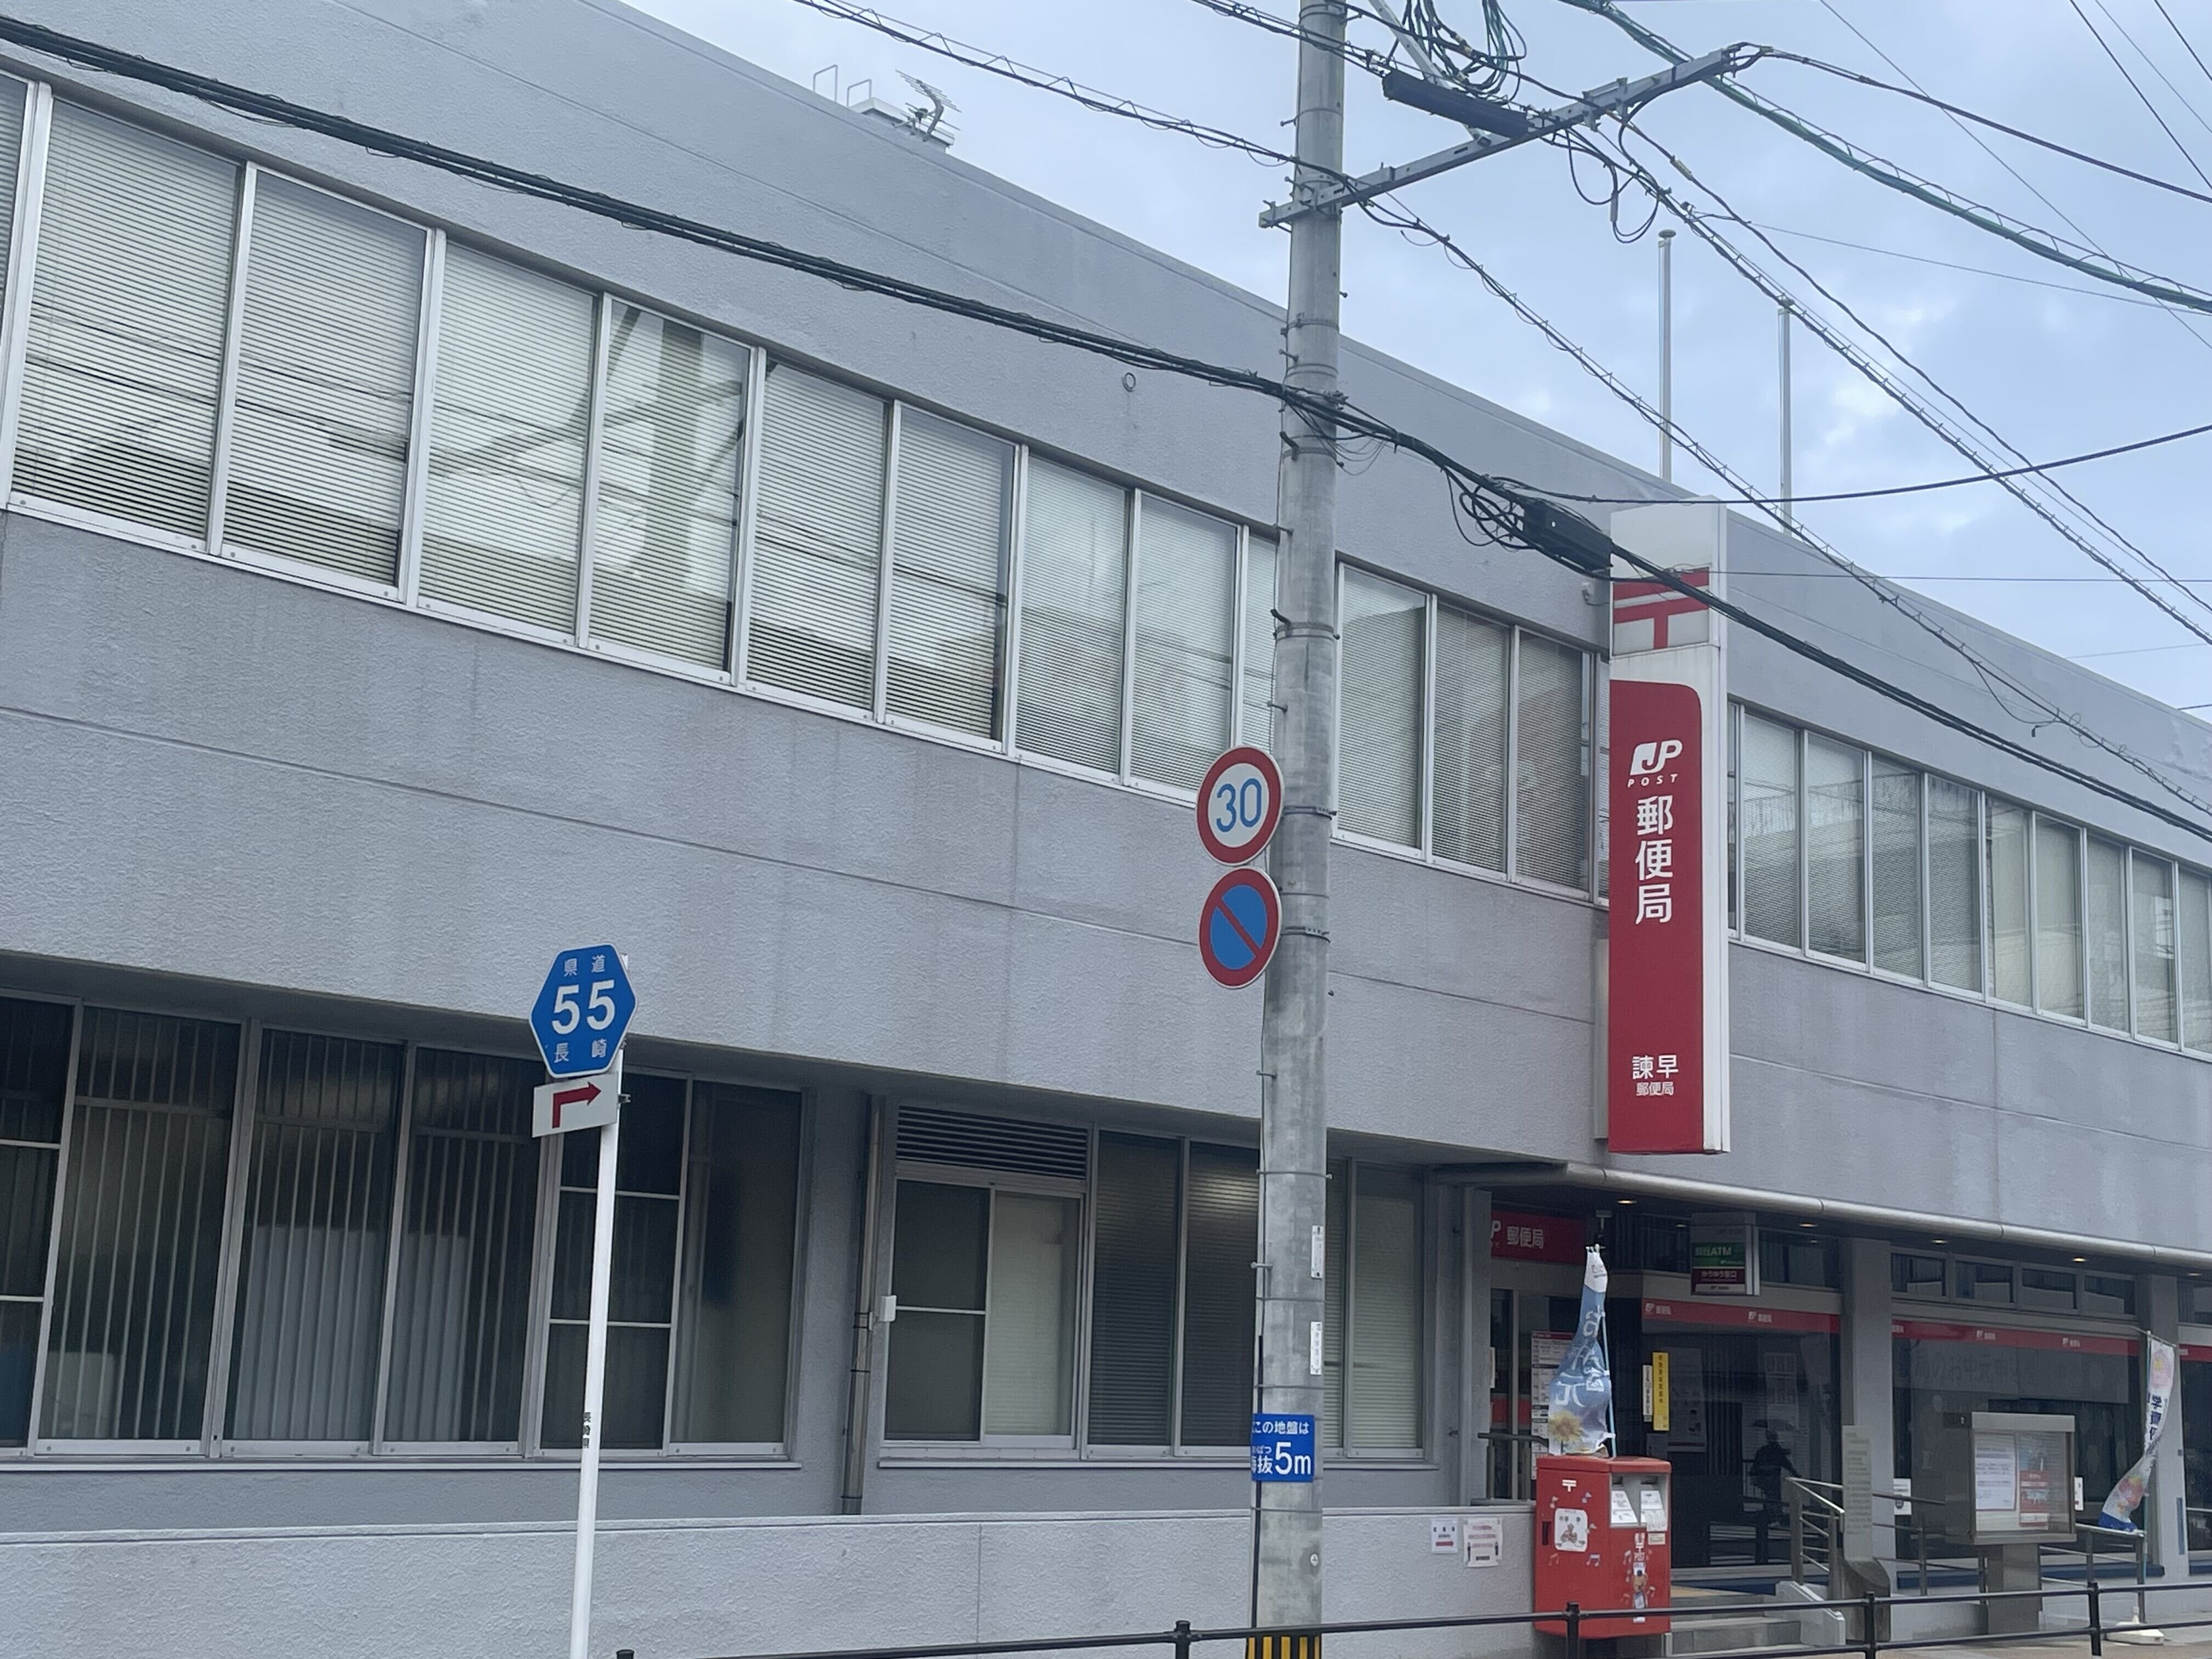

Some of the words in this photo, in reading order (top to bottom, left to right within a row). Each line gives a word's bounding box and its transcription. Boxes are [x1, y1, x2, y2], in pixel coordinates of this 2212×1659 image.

[1630, 740, 1683, 776] JP
[1627, 774, 1678, 788] POST
[1216, 778, 1262, 832] 30
[1635, 795, 1674, 924] 郵便局
[563, 955, 605, 977] 県道
[551, 979, 616, 1035] 55
[554, 1039, 607, 1063] 長崎
[1636, 1081, 1674, 1096] 郵便局
[1506, 1226, 1544, 1249] 郵便局
